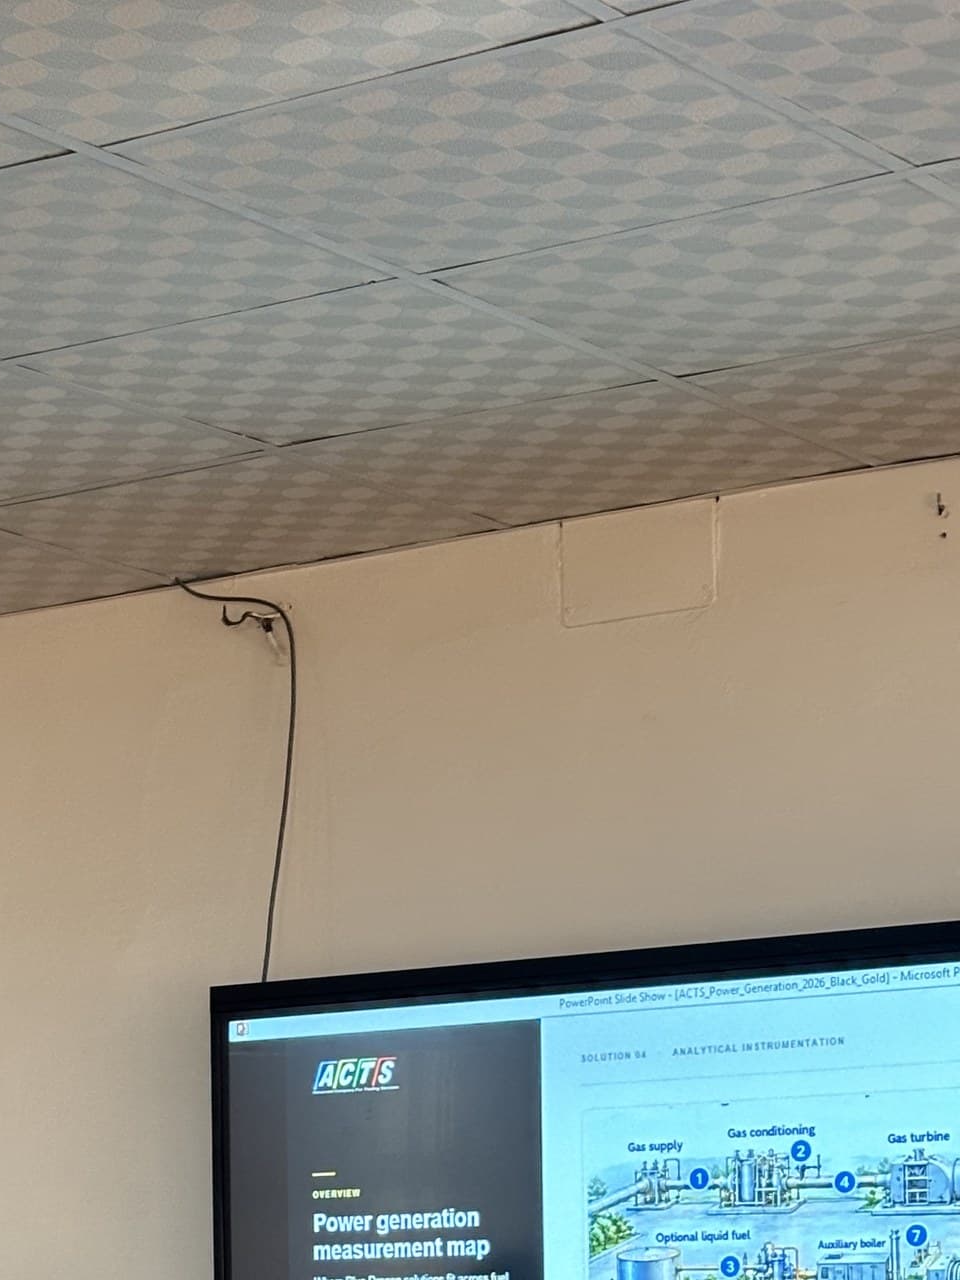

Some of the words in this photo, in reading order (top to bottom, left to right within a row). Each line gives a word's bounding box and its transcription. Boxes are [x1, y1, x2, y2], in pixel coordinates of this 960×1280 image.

[559, 996, 612, 1008] PowerPoint
[615, 994, 637, 1004] Slide
[640, 992, 665, 1002] Show
[900, 968, 950, 981] Microsoft
[672, 1044, 738, 1056] ANALYTICAL
[742, 1037, 845, 1052] INSTRUMENTATION
[581, 1052, 631, 1063] SOLUTION
[318, 1060, 395, 1087] ACTS
[728, 1128, 746, 1138] Gas
[750, 1124, 816, 1137] conditioning
[888, 1133, 907, 1143] Gas
[910, 1131, 950, 1142] turbine
[628, 1142, 646, 1152] Gas
[649, 1140, 683, 1153] supply
[312, 1188, 361, 1199] OVERVIEW
[313, 1213, 373, 1233] Power
[376, 1208, 480, 1235] generation
[656, 1231, 699, 1244] Optional
[701, 1231, 730, 1242] liquid
[731, 1230, 750, 1240] fuel
[818, 1240, 858, 1249] Auxiliary
[860, 1239, 886, 1248] boiler
[313, 1237, 444, 1260] measurement
[447, 1239, 491, 1261] map
